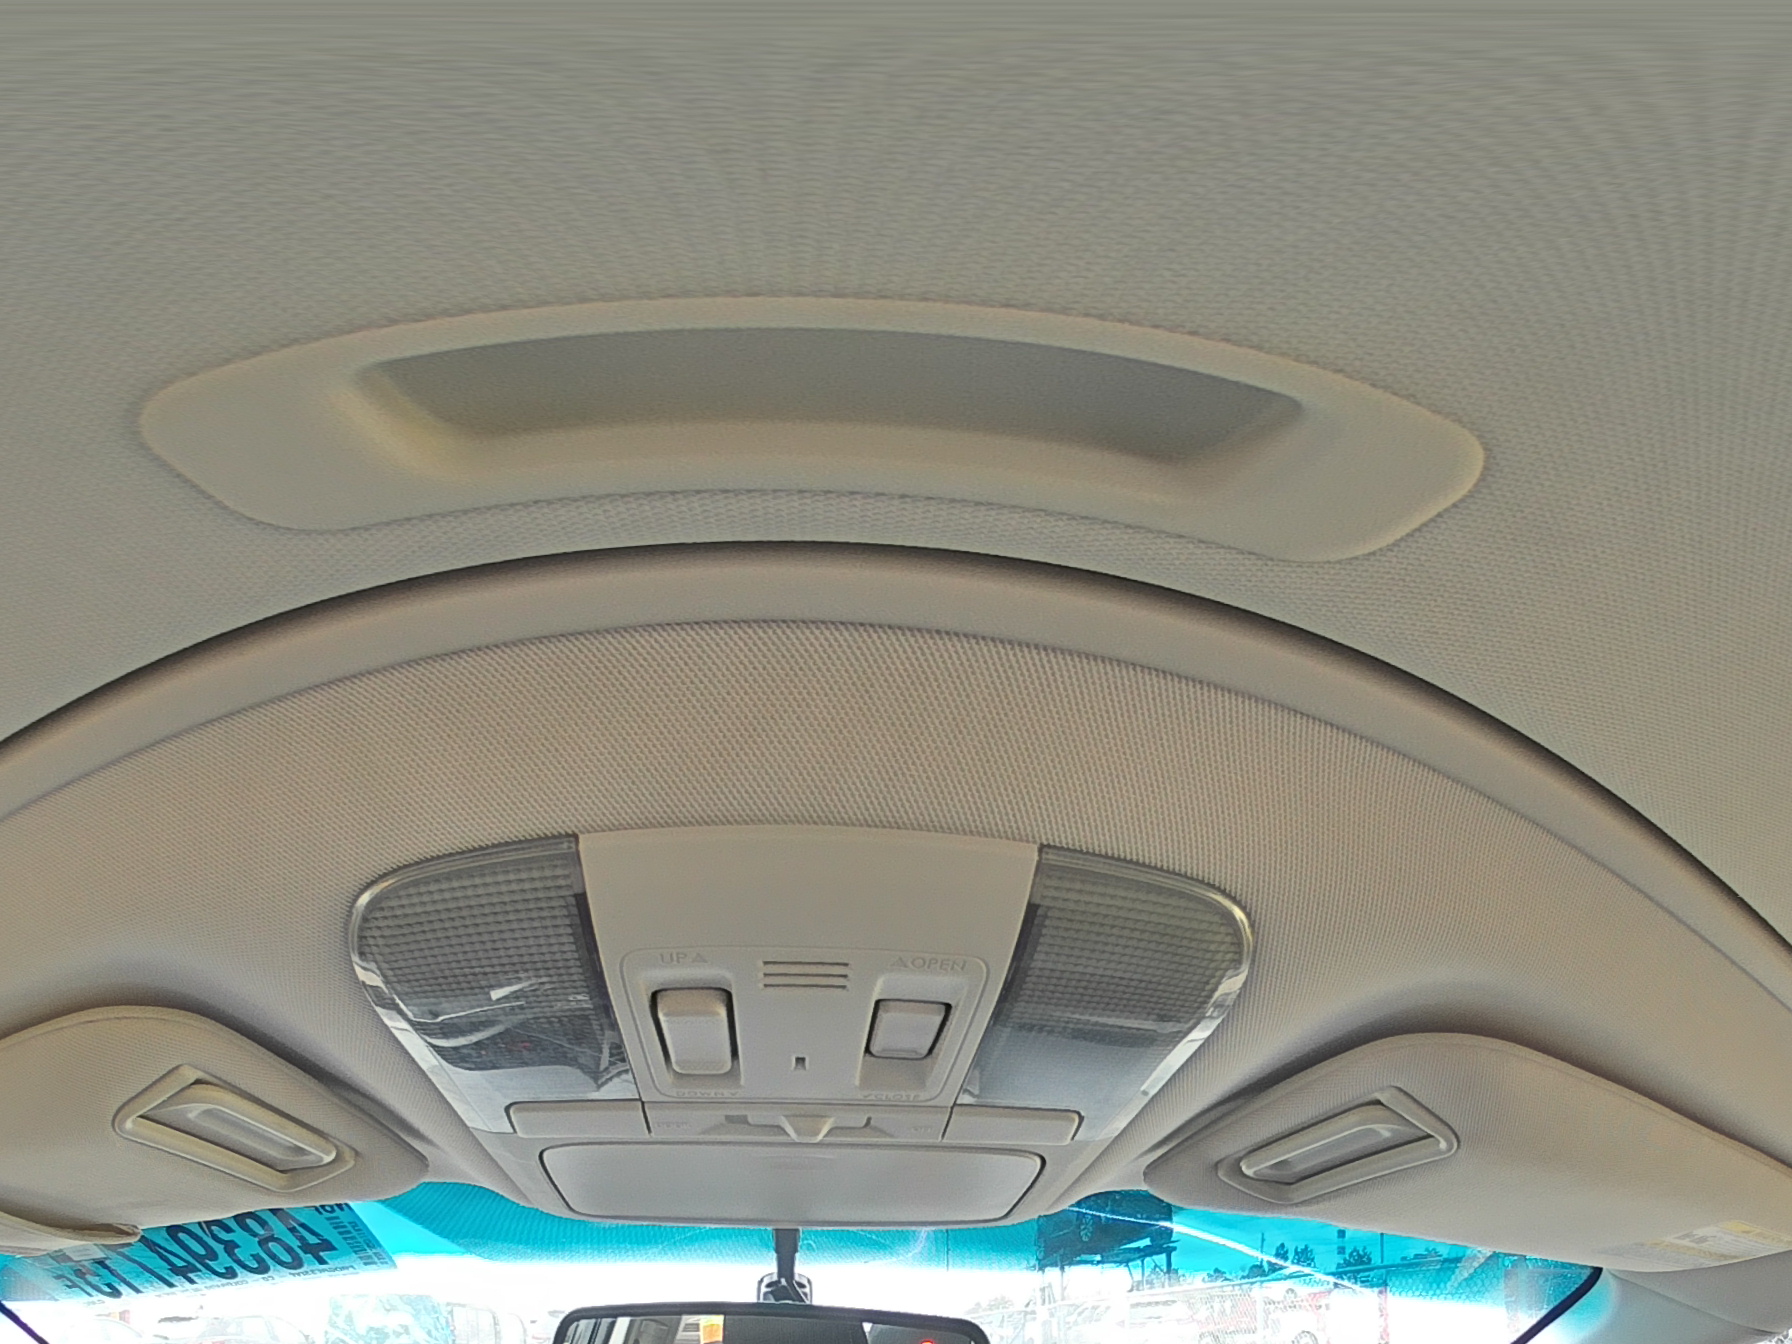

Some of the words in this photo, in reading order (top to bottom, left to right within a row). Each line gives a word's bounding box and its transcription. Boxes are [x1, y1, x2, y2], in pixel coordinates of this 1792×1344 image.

[659, 953, 687, 965] UP
[910, 956, 967, 972] OPEN
[676, 1089, 727, 1098] DOWN
[875, 1091, 921, 1100] CLOSE
